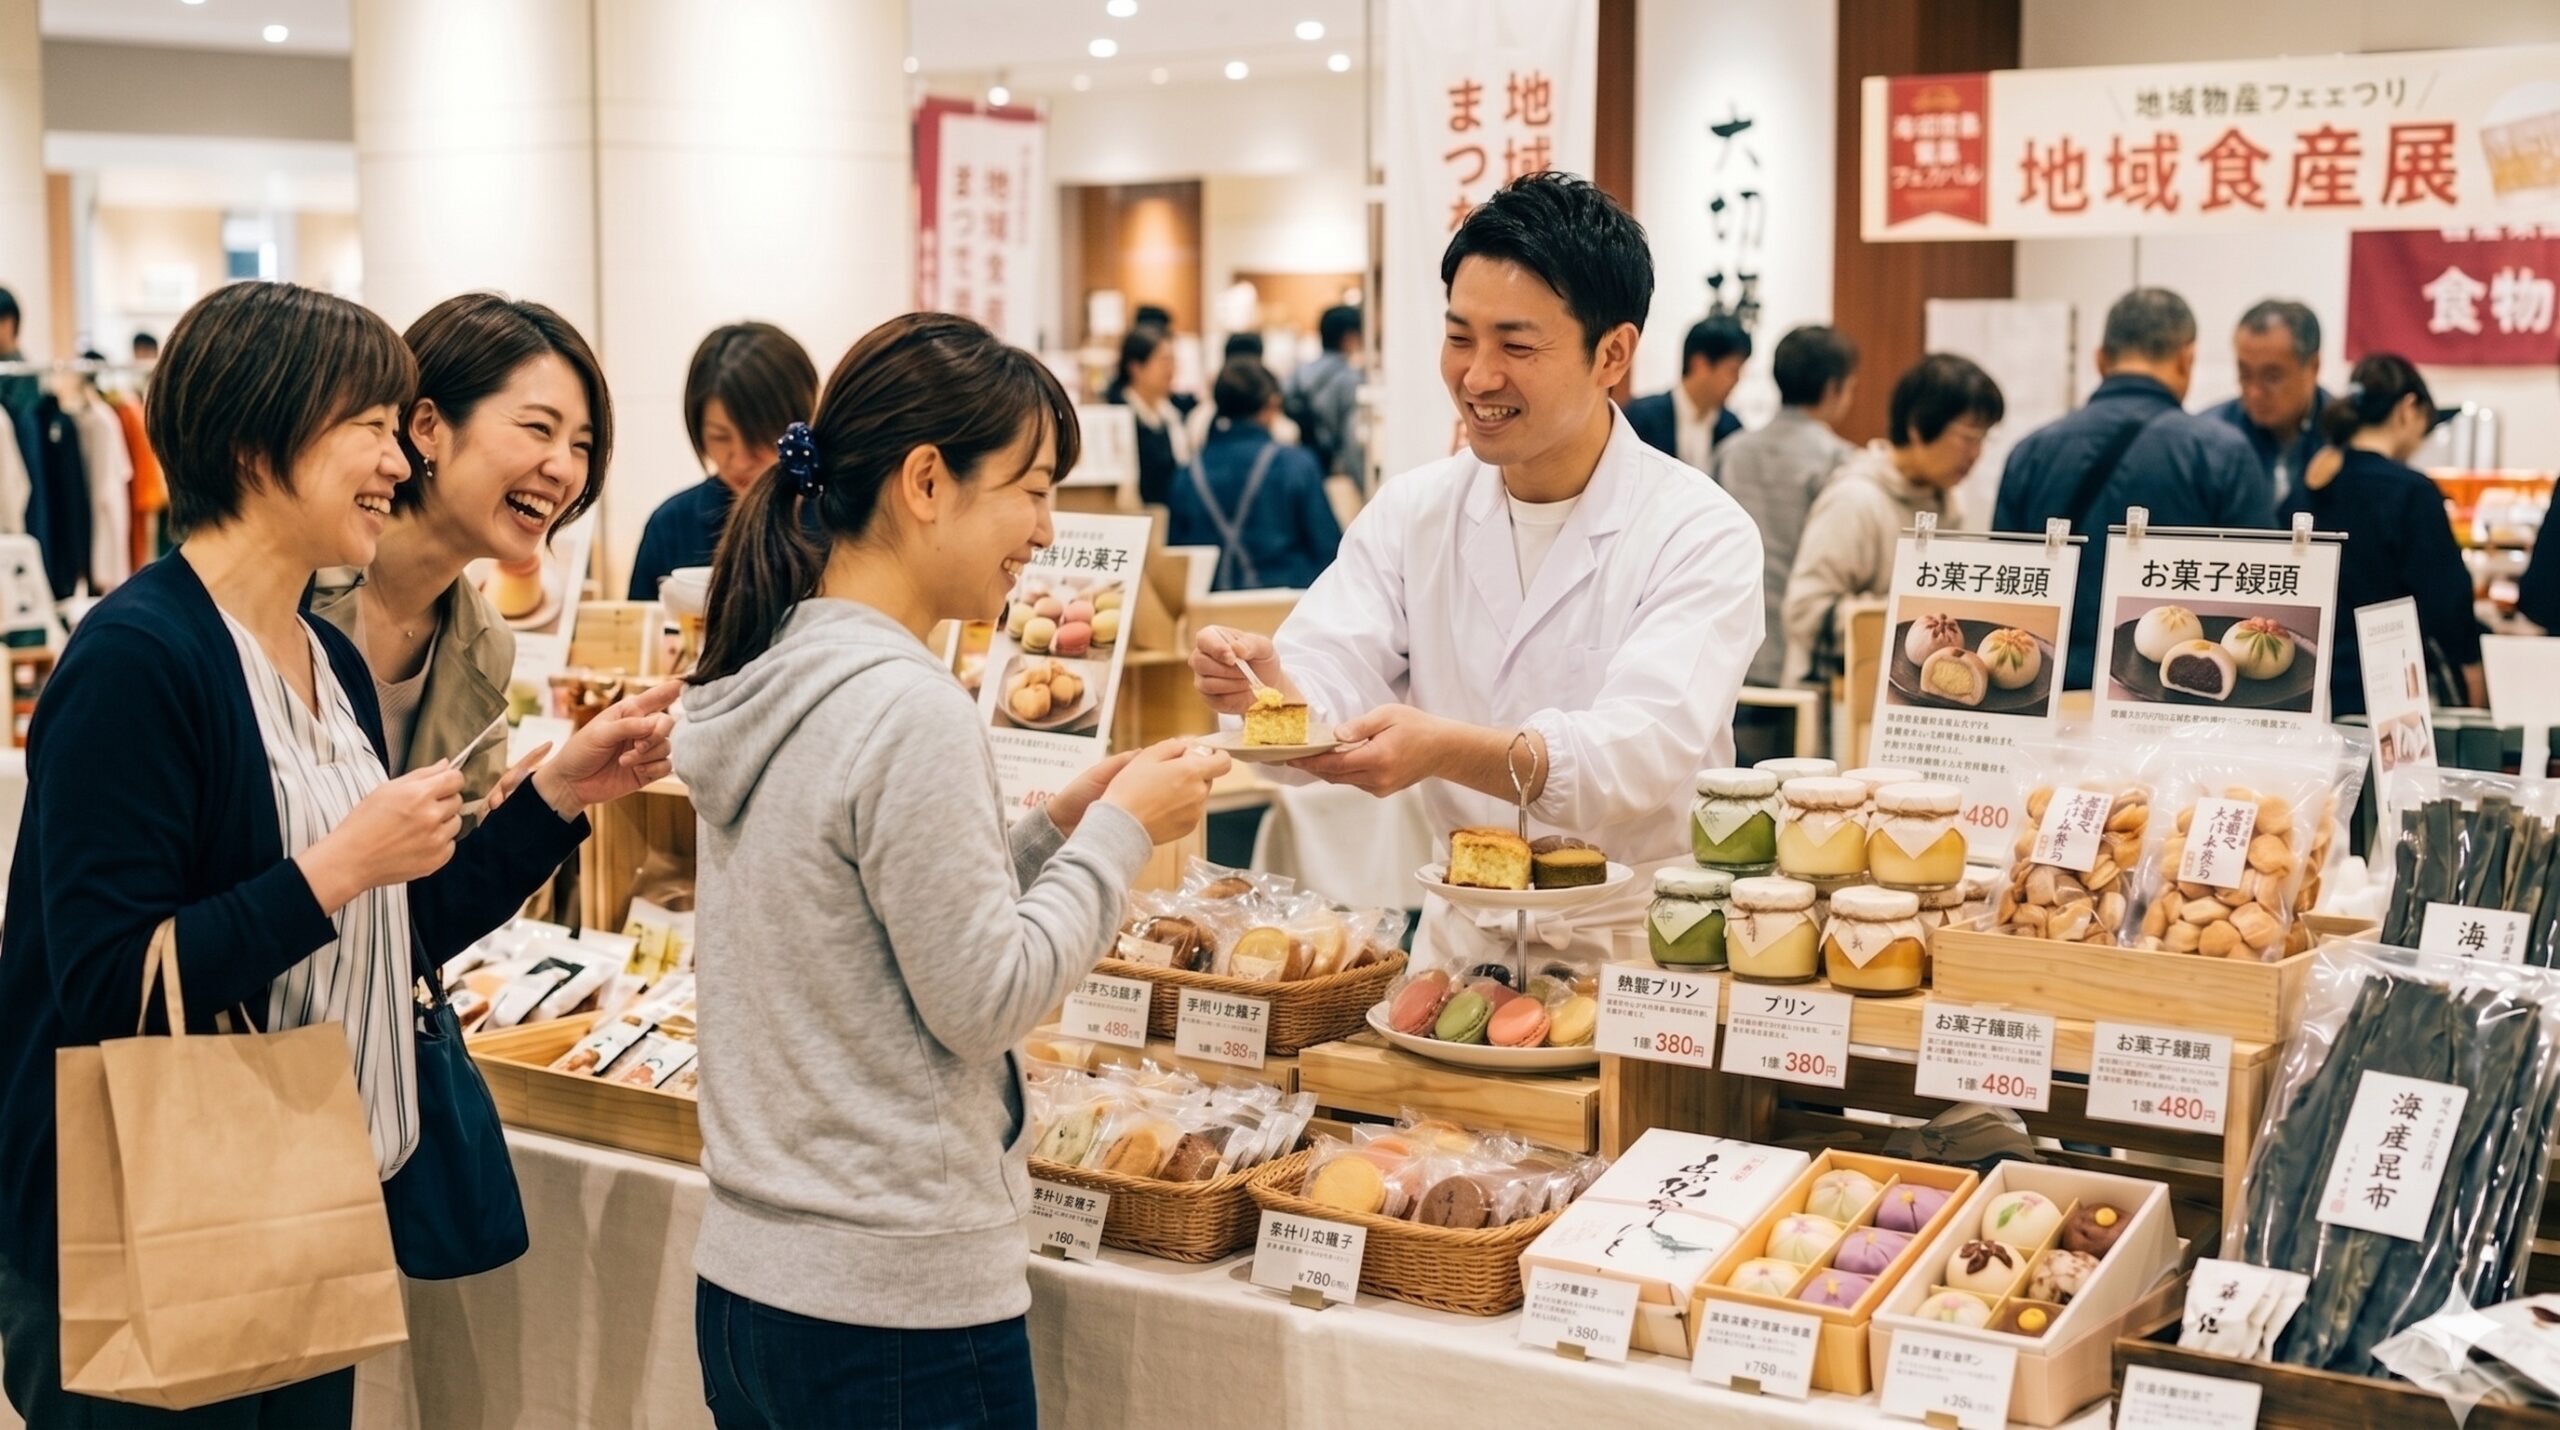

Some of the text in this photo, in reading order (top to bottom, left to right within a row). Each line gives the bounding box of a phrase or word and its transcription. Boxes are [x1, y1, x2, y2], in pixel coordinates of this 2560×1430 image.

[2019, 121, 2460, 215] 地域食産展
[2422, 265, 2556, 335] 食物
[2458, 921, 2488, 957] 海
[1765, 995, 1815, 1016] プリン
[1655, 1032, 1705, 1057] 380円
[1785, 1051, 1837, 1077] 380円
[1981, 1074, 2037, 1100] 480円
[2157, 1096, 2216, 1123] 480円
[2362, 1092, 2424, 1212] 海産昆布
